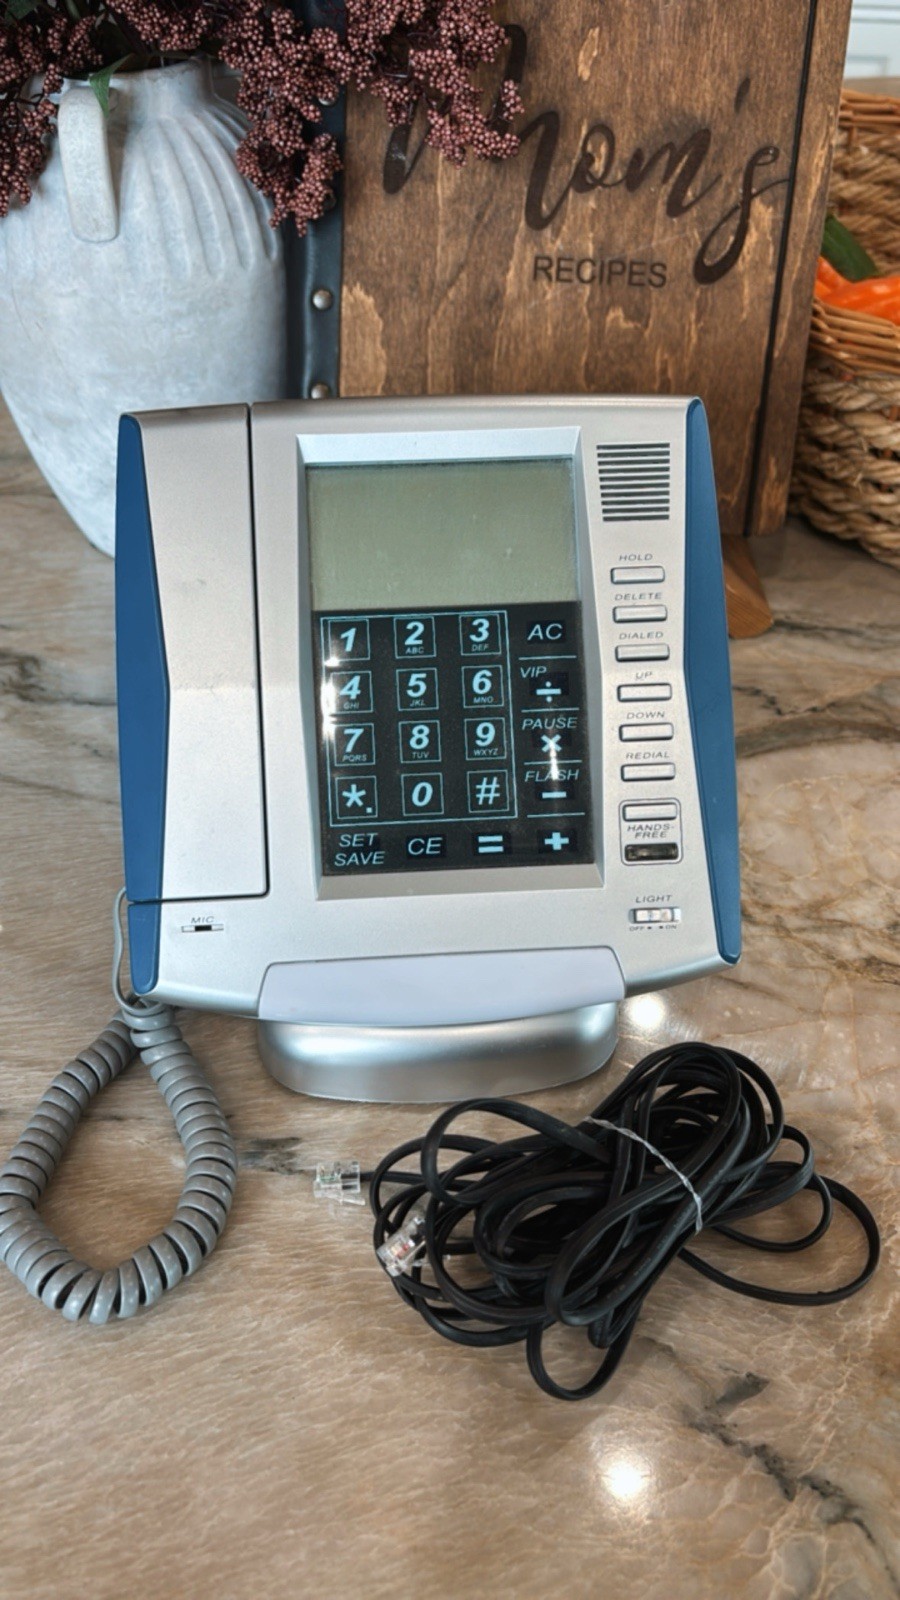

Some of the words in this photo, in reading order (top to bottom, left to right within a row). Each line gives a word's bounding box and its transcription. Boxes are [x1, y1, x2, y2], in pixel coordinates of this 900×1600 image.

[532, 255, 668, 289] RECIPES
[618, 553, 653, 562] HOLD
[614, 592, 662, 601] DELETE
[405, 621, 425, 646] 2
[469, 618, 490, 643] 3
[527, 623, 563, 641] AC
[340, 627, 357, 652] 1
[405, 646, 424, 655] ABC
[471, 643, 489, 652] DEF
[520, 666, 547, 678] VIP
[339, 675, 361, 700] 4
[406, 673, 427, 698] 5
[472, 669, 493, 695] 6
[473, 696, 494, 704] MNO
[626, 711, 665, 720] DOWN
[521, 717, 578, 731] PAUSE
[343, 728, 364, 753] 7
[409, 724, 430, 750] 8
[475, 722, 496, 747] 9
[342, 754, 367, 762] PQRS
[412, 751, 429, 759] TUV
[474, 748, 499, 756] WXYZ
[625, 751, 671, 760] REDIAL
[524, 769, 580, 783] FLASH
[411, 781, 433, 807] 0
[338, 832, 379, 848] SET
[634, 830, 667, 839] FREE
[407, 836, 444, 856] CE
[334, 851, 386, 867] SAVE
[635, 894, 673, 904] LIGHT
[190, 915, 215, 924] MIC
